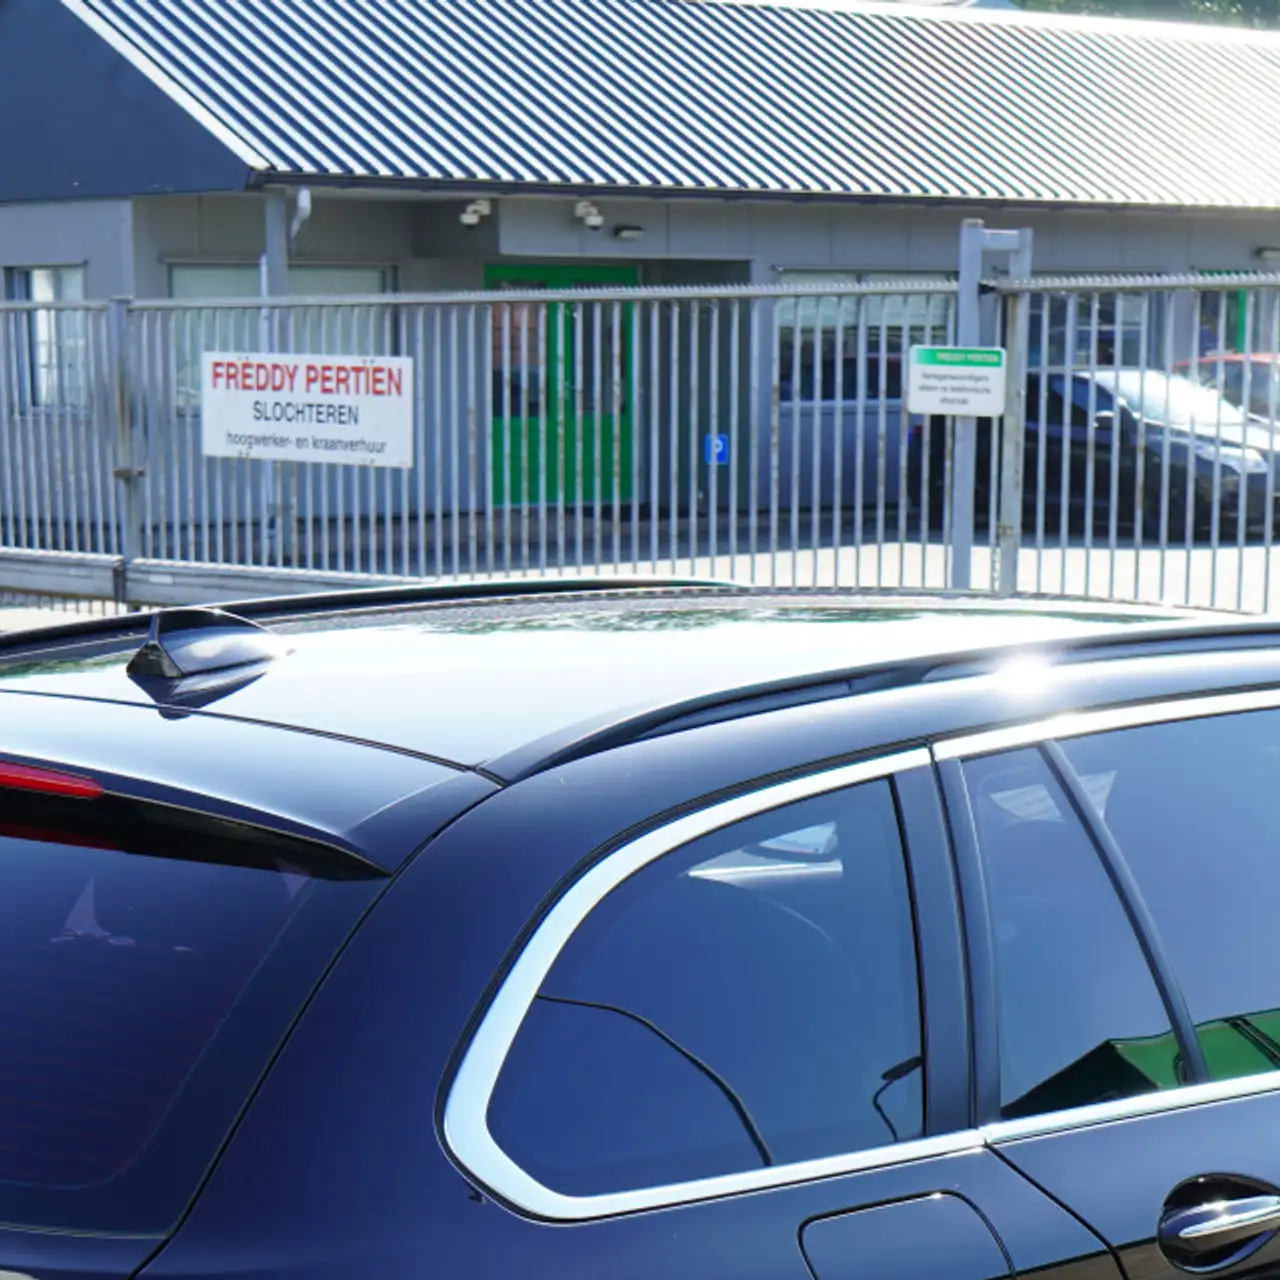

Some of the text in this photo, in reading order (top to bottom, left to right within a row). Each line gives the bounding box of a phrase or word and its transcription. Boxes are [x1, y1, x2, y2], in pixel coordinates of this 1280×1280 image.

[211, 361, 402, 397] FREDDY PERTIEN
[252, 400, 360, 425] SLOCHTEREN
[295, 436, 309, 449] en
